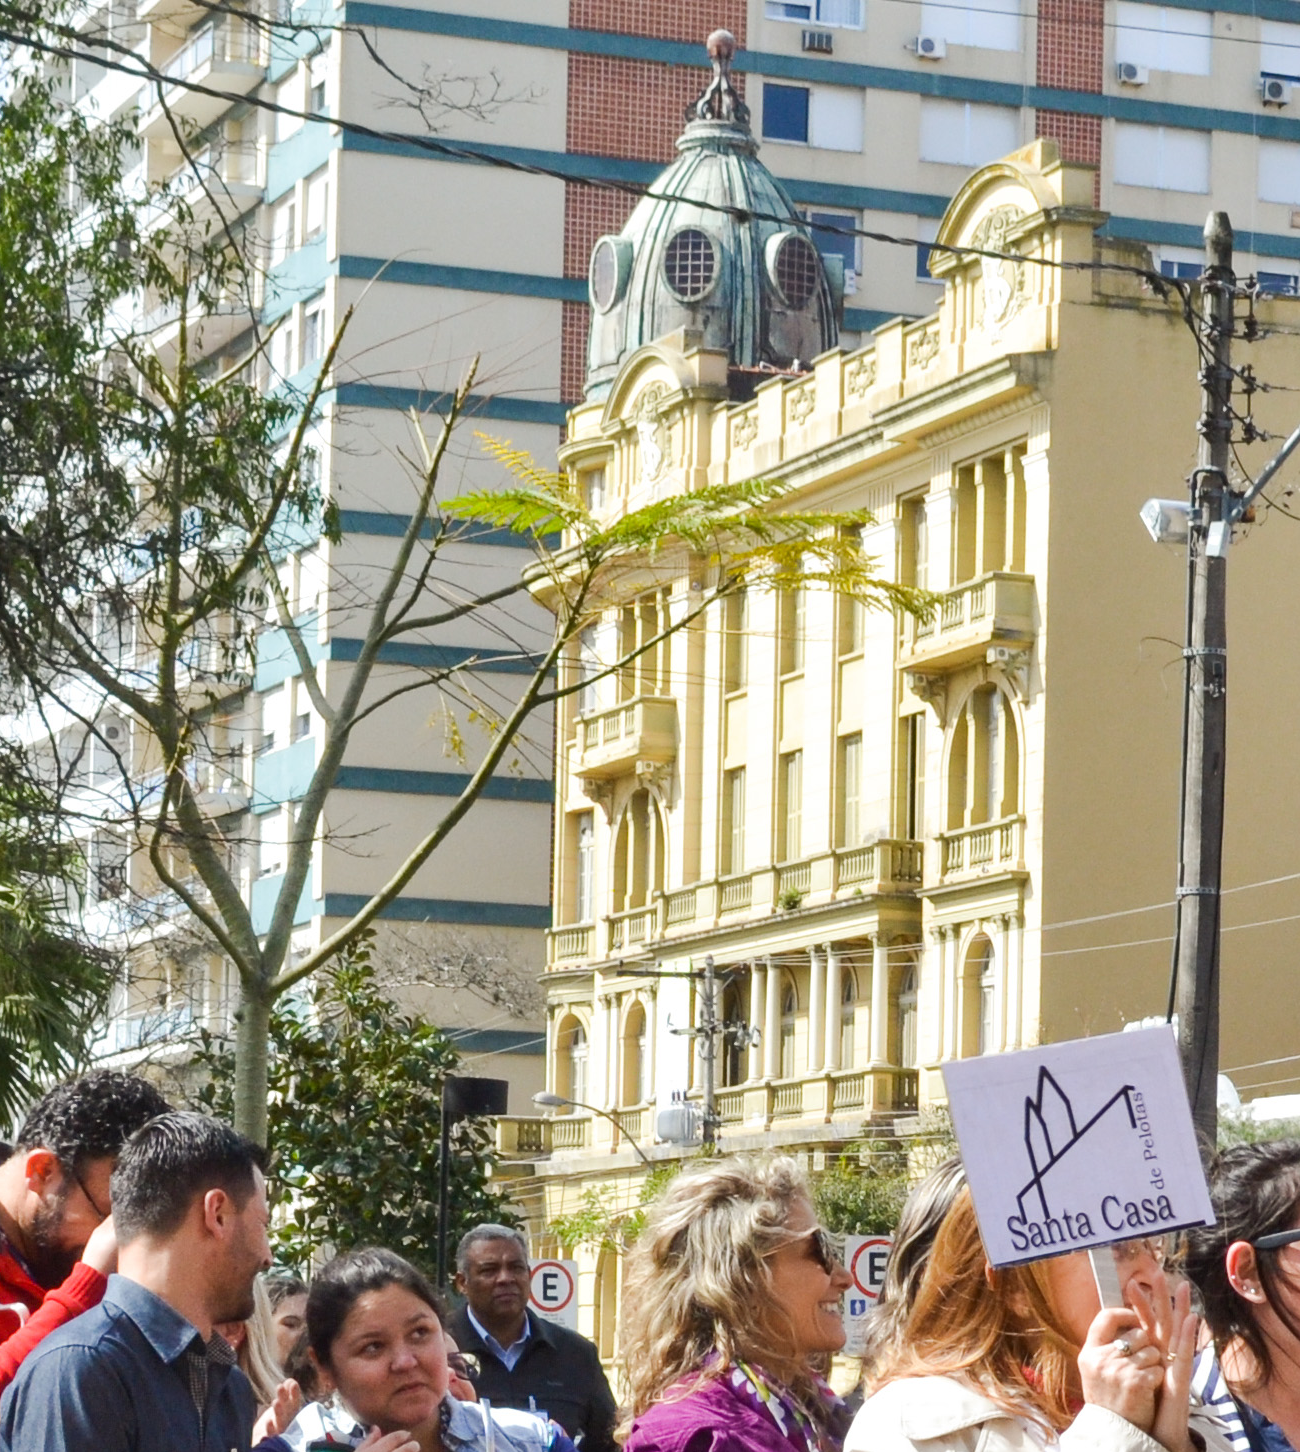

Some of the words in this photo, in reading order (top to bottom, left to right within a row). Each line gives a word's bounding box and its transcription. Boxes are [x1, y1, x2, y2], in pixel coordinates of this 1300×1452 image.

[1133, 1092, 1158, 1161] Pelotas
[1150, 1167, 1165, 1190] de
[1007, 1209, 1096, 1252] Santa
[1101, 1193, 1177, 1232] Casa
[869, 1252, 888, 1286] E
[542, 1273, 558, 1301] E
